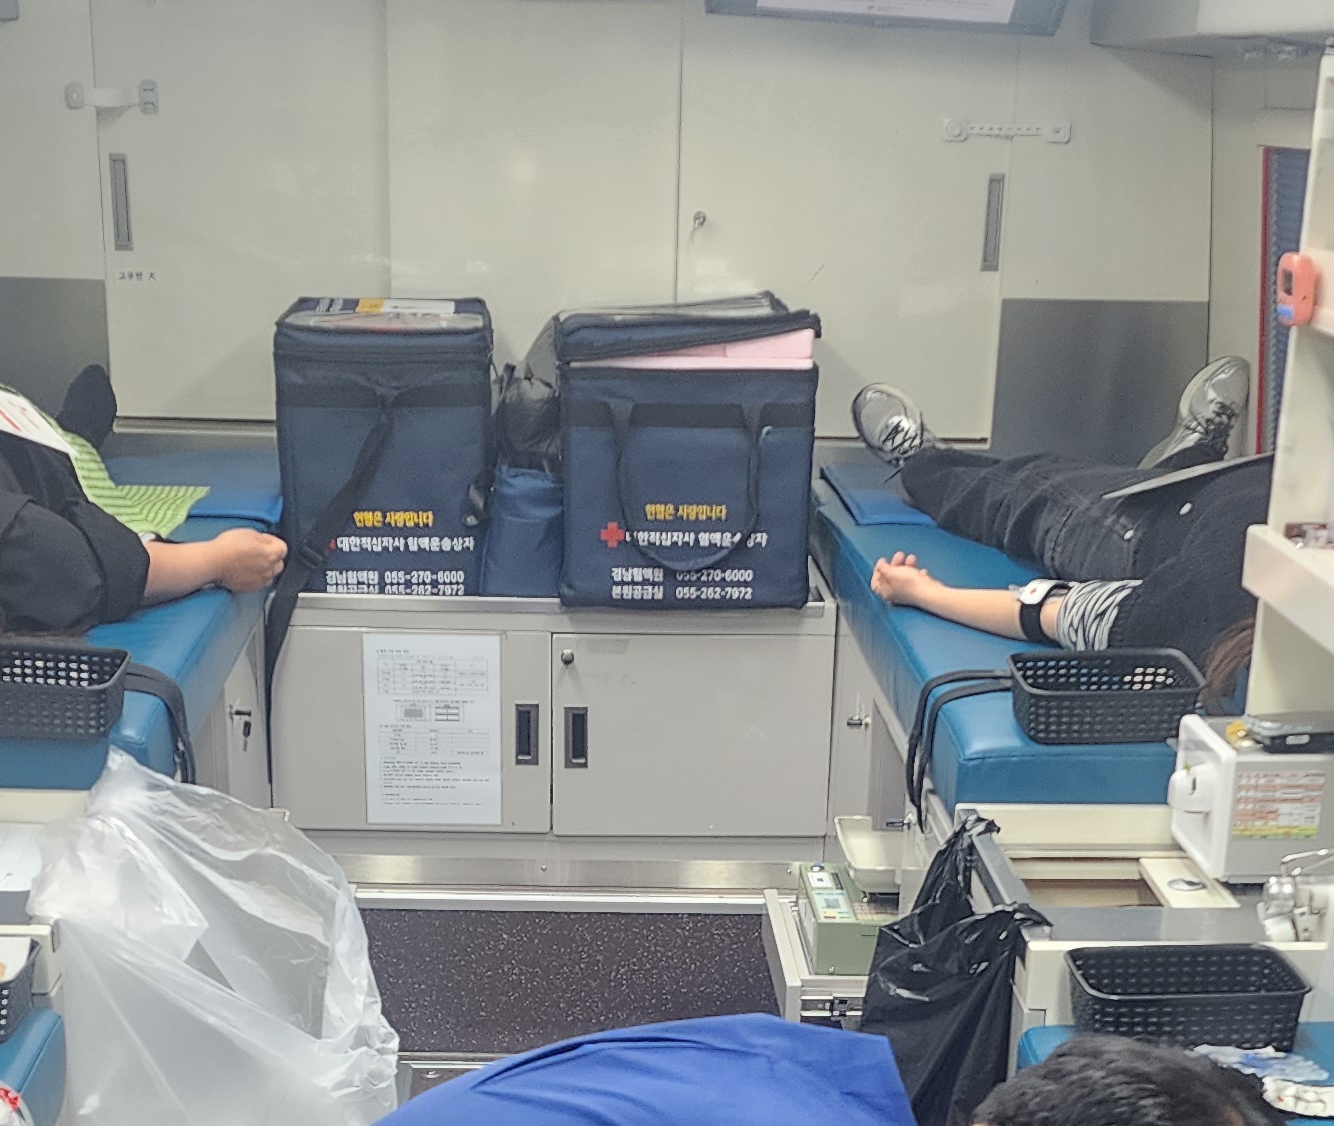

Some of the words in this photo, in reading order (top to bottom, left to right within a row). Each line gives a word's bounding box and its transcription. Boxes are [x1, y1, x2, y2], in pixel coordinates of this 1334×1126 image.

[353, 511, 383, 528] 헌혈은
[385, 511, 434, 528] 사랑입니다
[645, 504, 674, 520] 헌혈은
[677, 504, 727, 521] 사랑입니다
[337, 536, 405, 552] 대한적십자사
[407, 536, 475, 552] 혈액운송상자
[326, 571, 379, 584] 경남혈액원
[385, 571, 465, 584] 055-270-6000
[611, 567, 664, 582] 경남혈액원
[675, 569, 754, 582] 055-270-6000
[611, 586, 664, 600] 본원공급실
[675, 587, 753, 600] 055-262-7972
